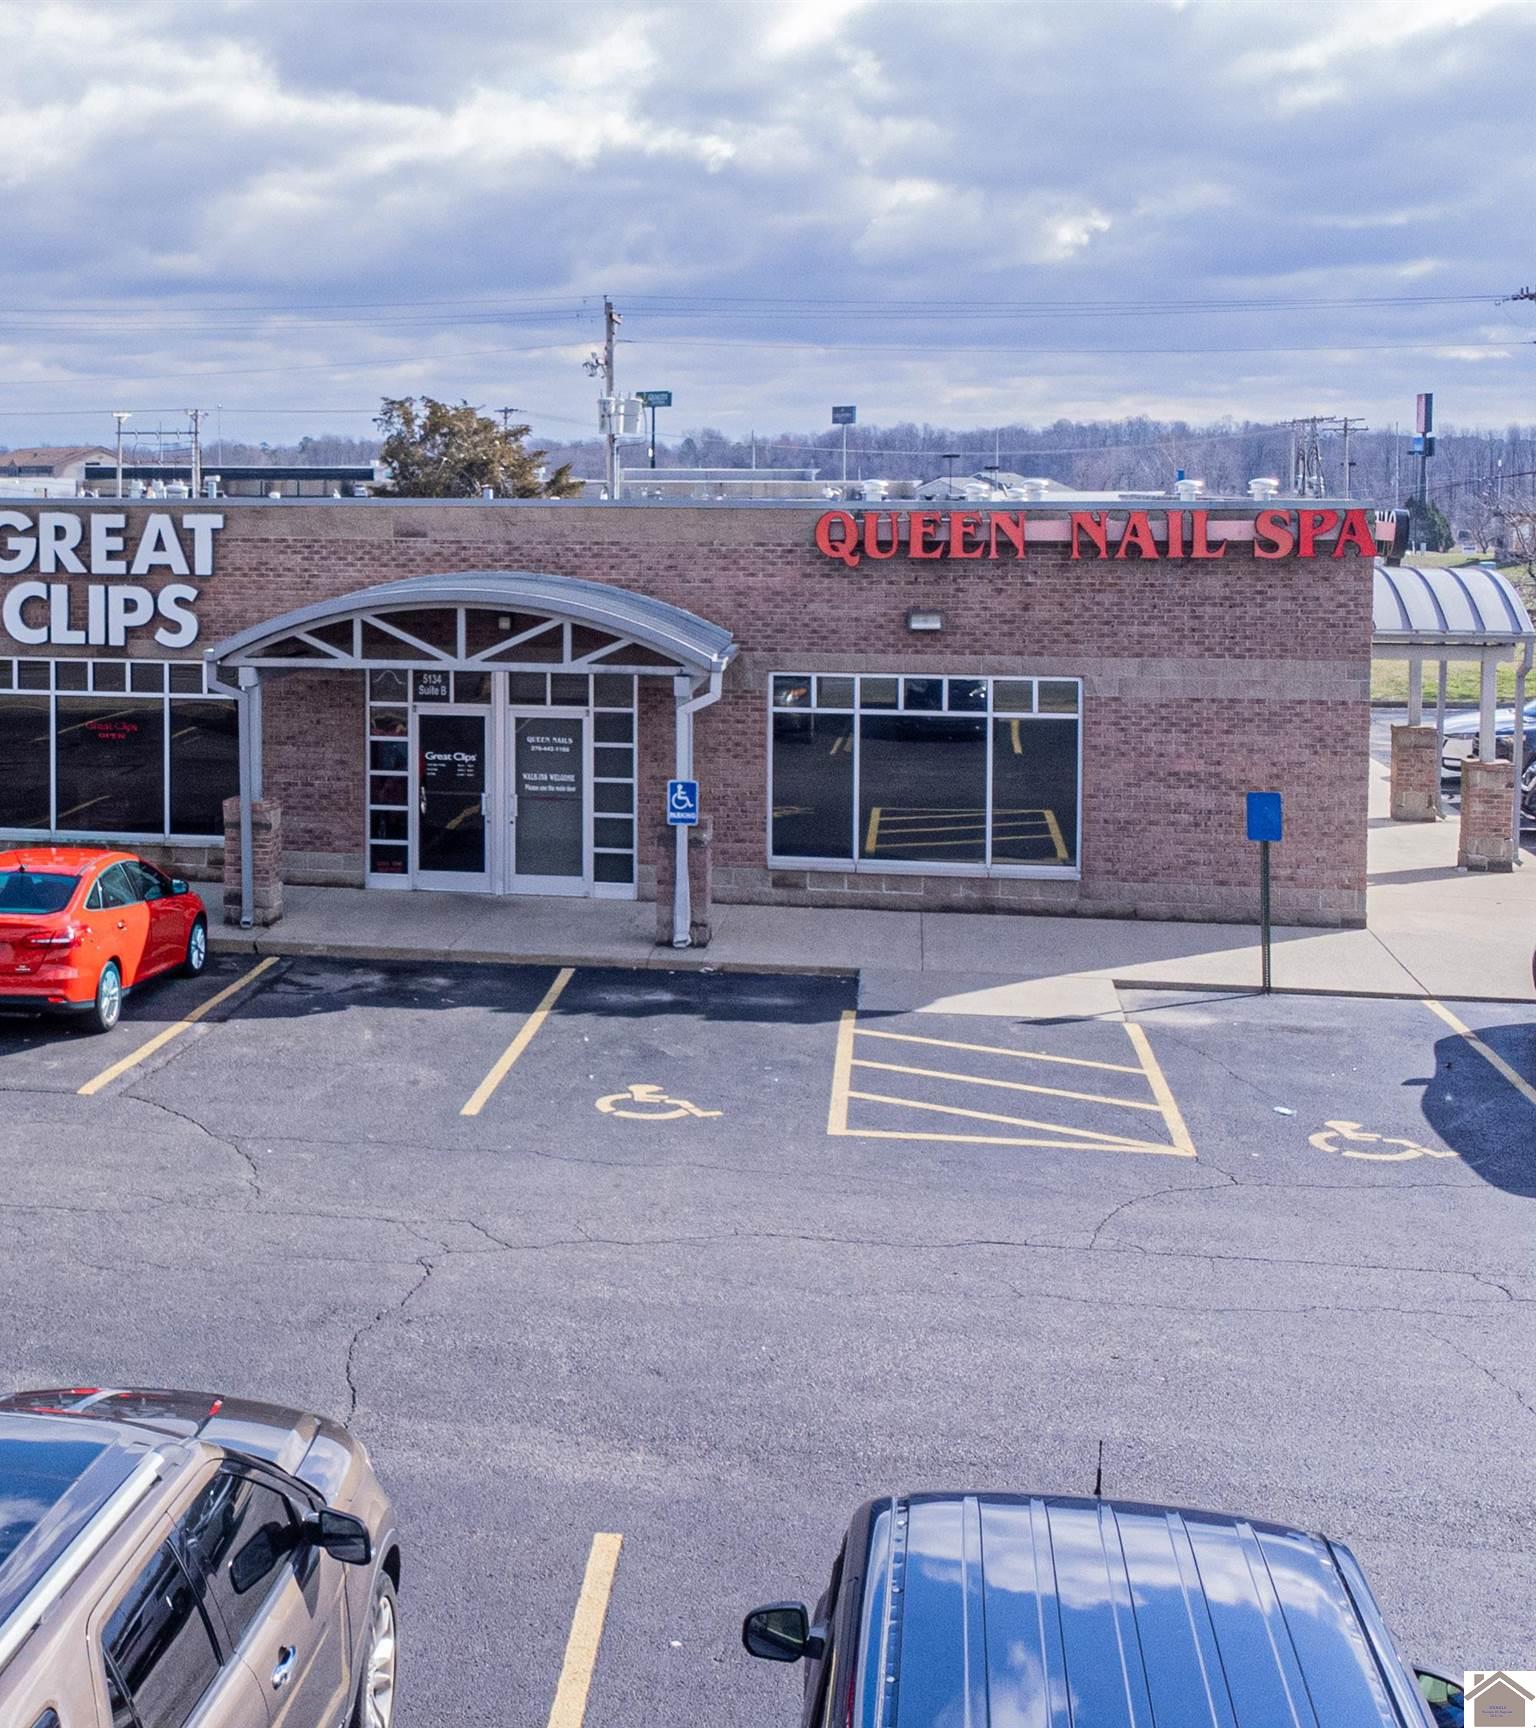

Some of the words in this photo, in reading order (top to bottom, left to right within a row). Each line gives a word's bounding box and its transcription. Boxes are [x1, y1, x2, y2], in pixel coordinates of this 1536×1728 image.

[814, 510, 1029, 569] QUEEN
[1071, 510, 1228, 561] NAIL
[1252, 508, 1379, 560] SPA
[2, 581, 200, 649] CLIPS
[422, 673, 443, 685] 5134
[418, 685, 440, 696] Suite
[440, 685, 447, 696] B
[424, 751, 452, 761] Great
[453, 751, 477, 764] Clips
